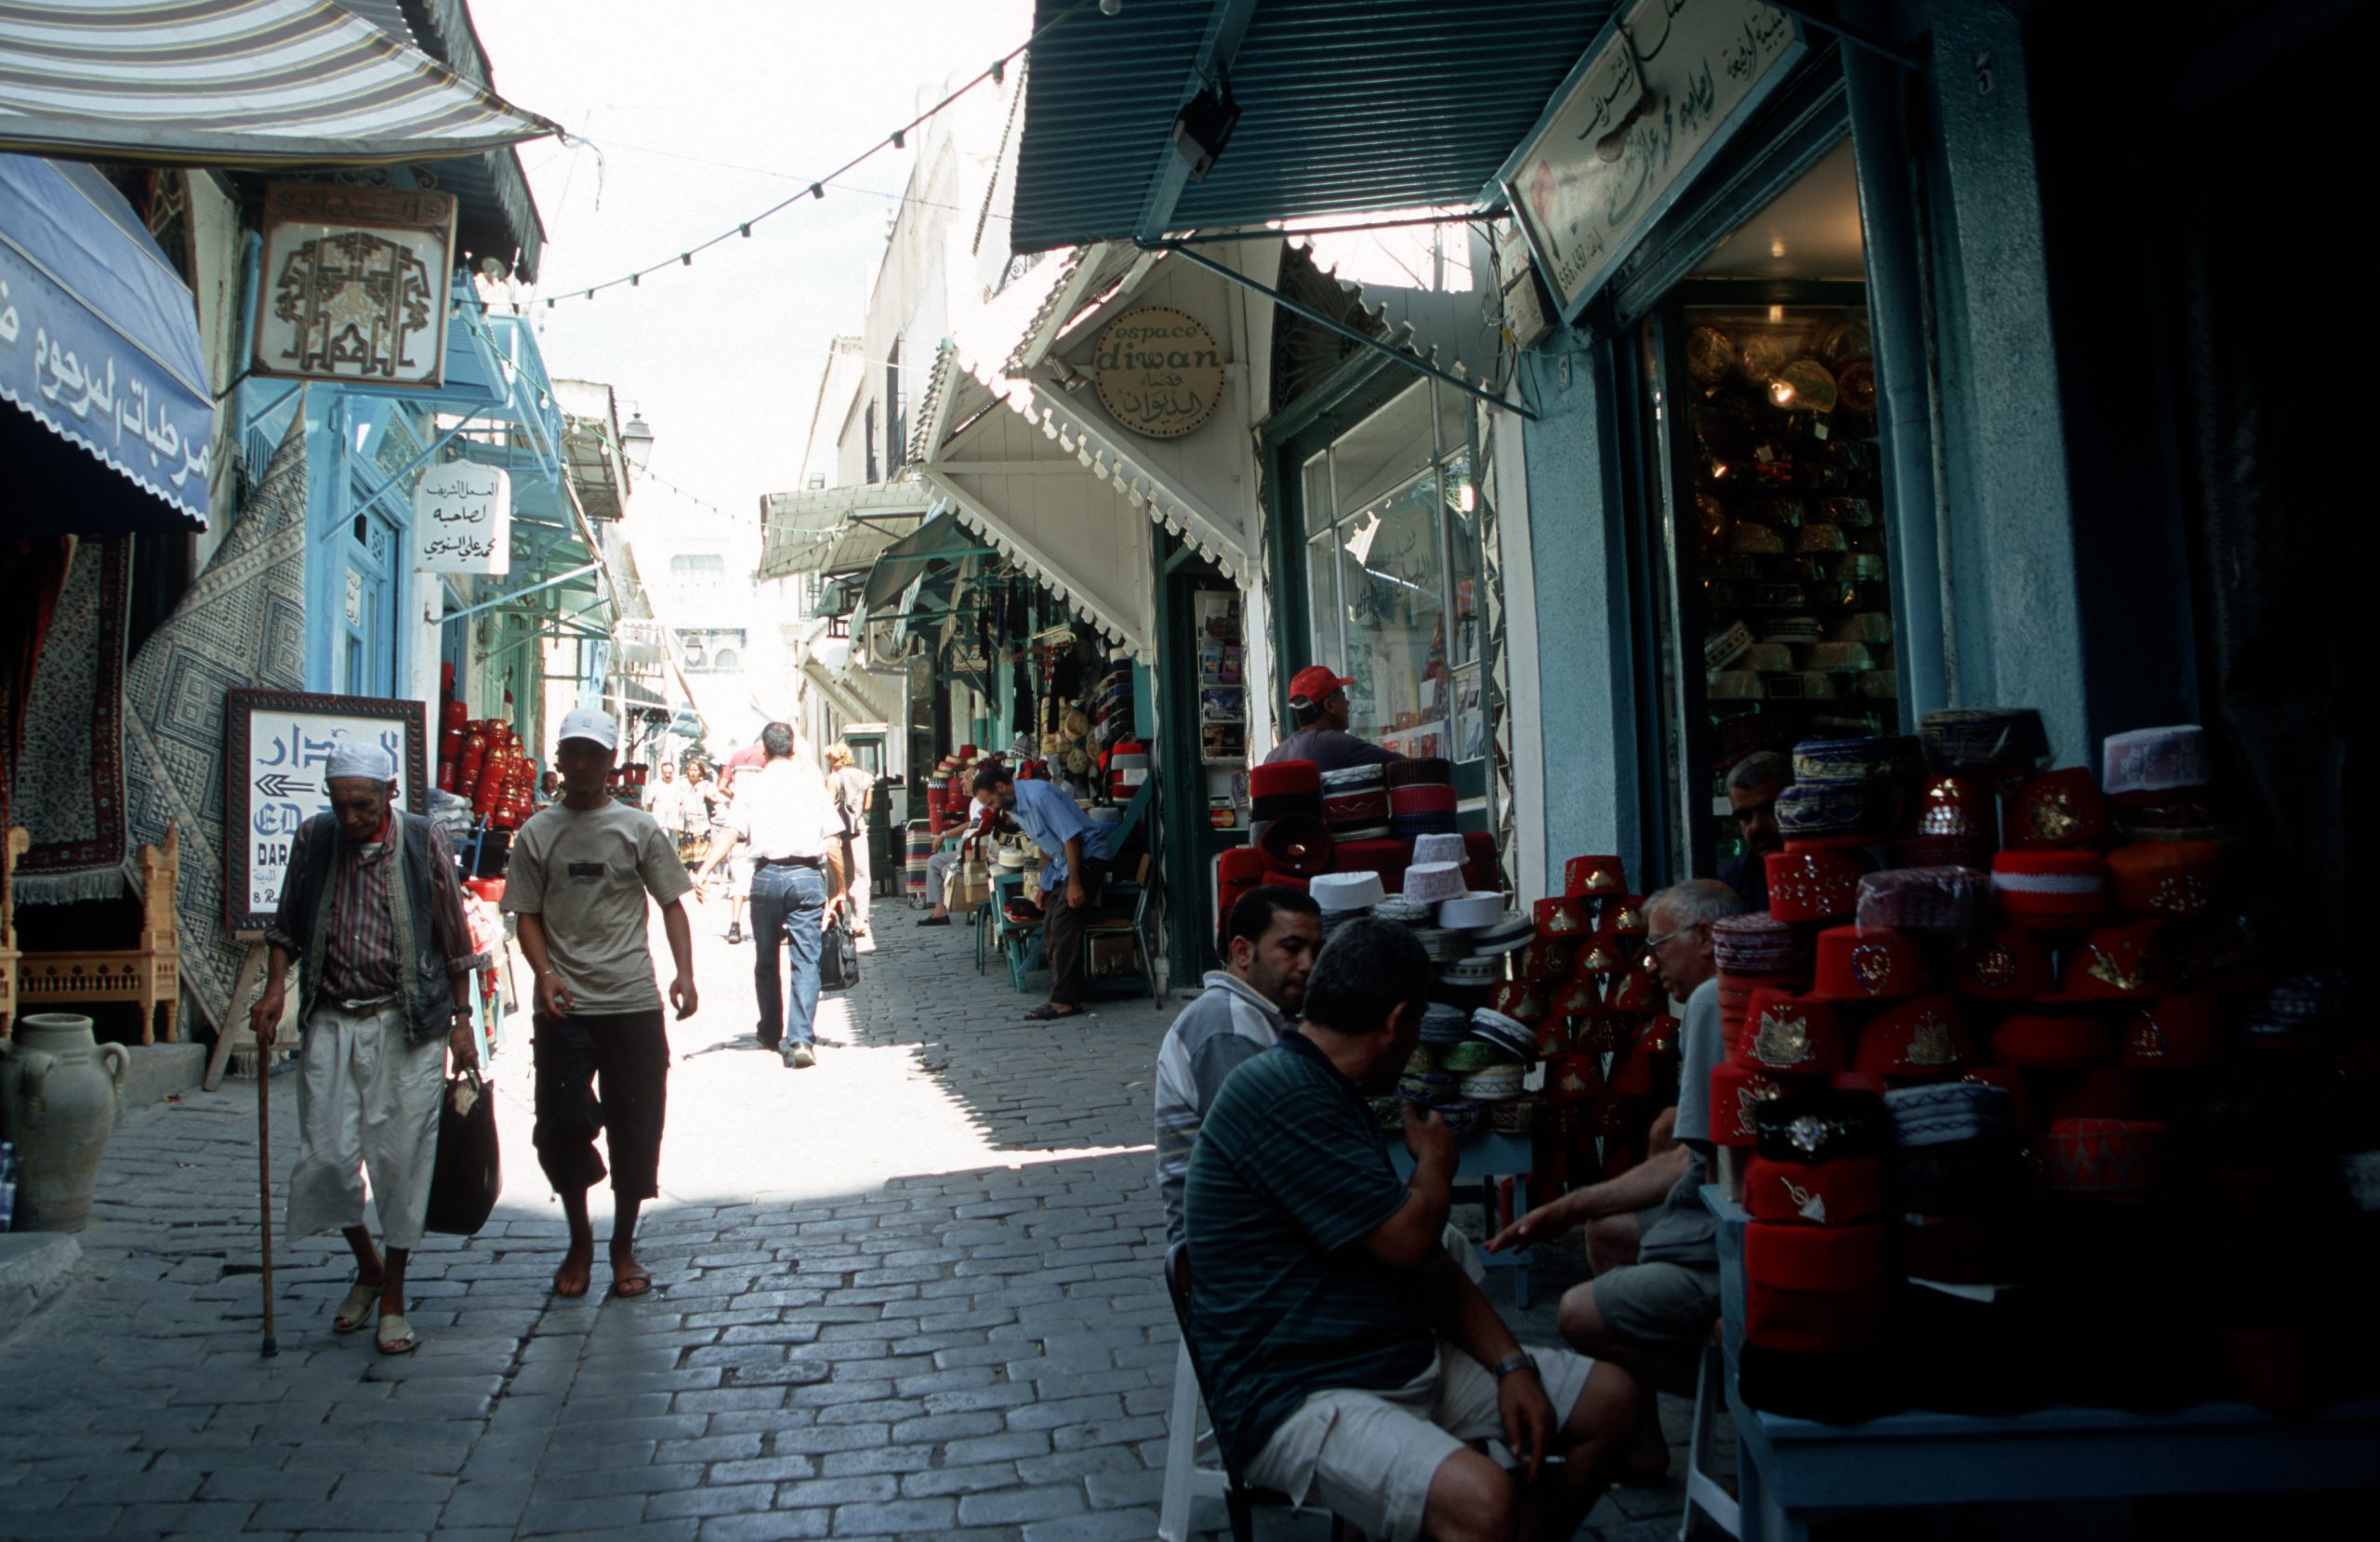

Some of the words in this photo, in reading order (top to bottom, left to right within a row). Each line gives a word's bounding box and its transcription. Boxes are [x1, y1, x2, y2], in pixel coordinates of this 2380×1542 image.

[1115, 324, 1198, 345] espace
[1097, 341, 1221, 371] diwan
[426, 480, 465, 499] الشريف
[458, 481, 499, 499] العمل
[432, 504, 486, 529] لصاحبه
[253, 891, 261, 904] 8
